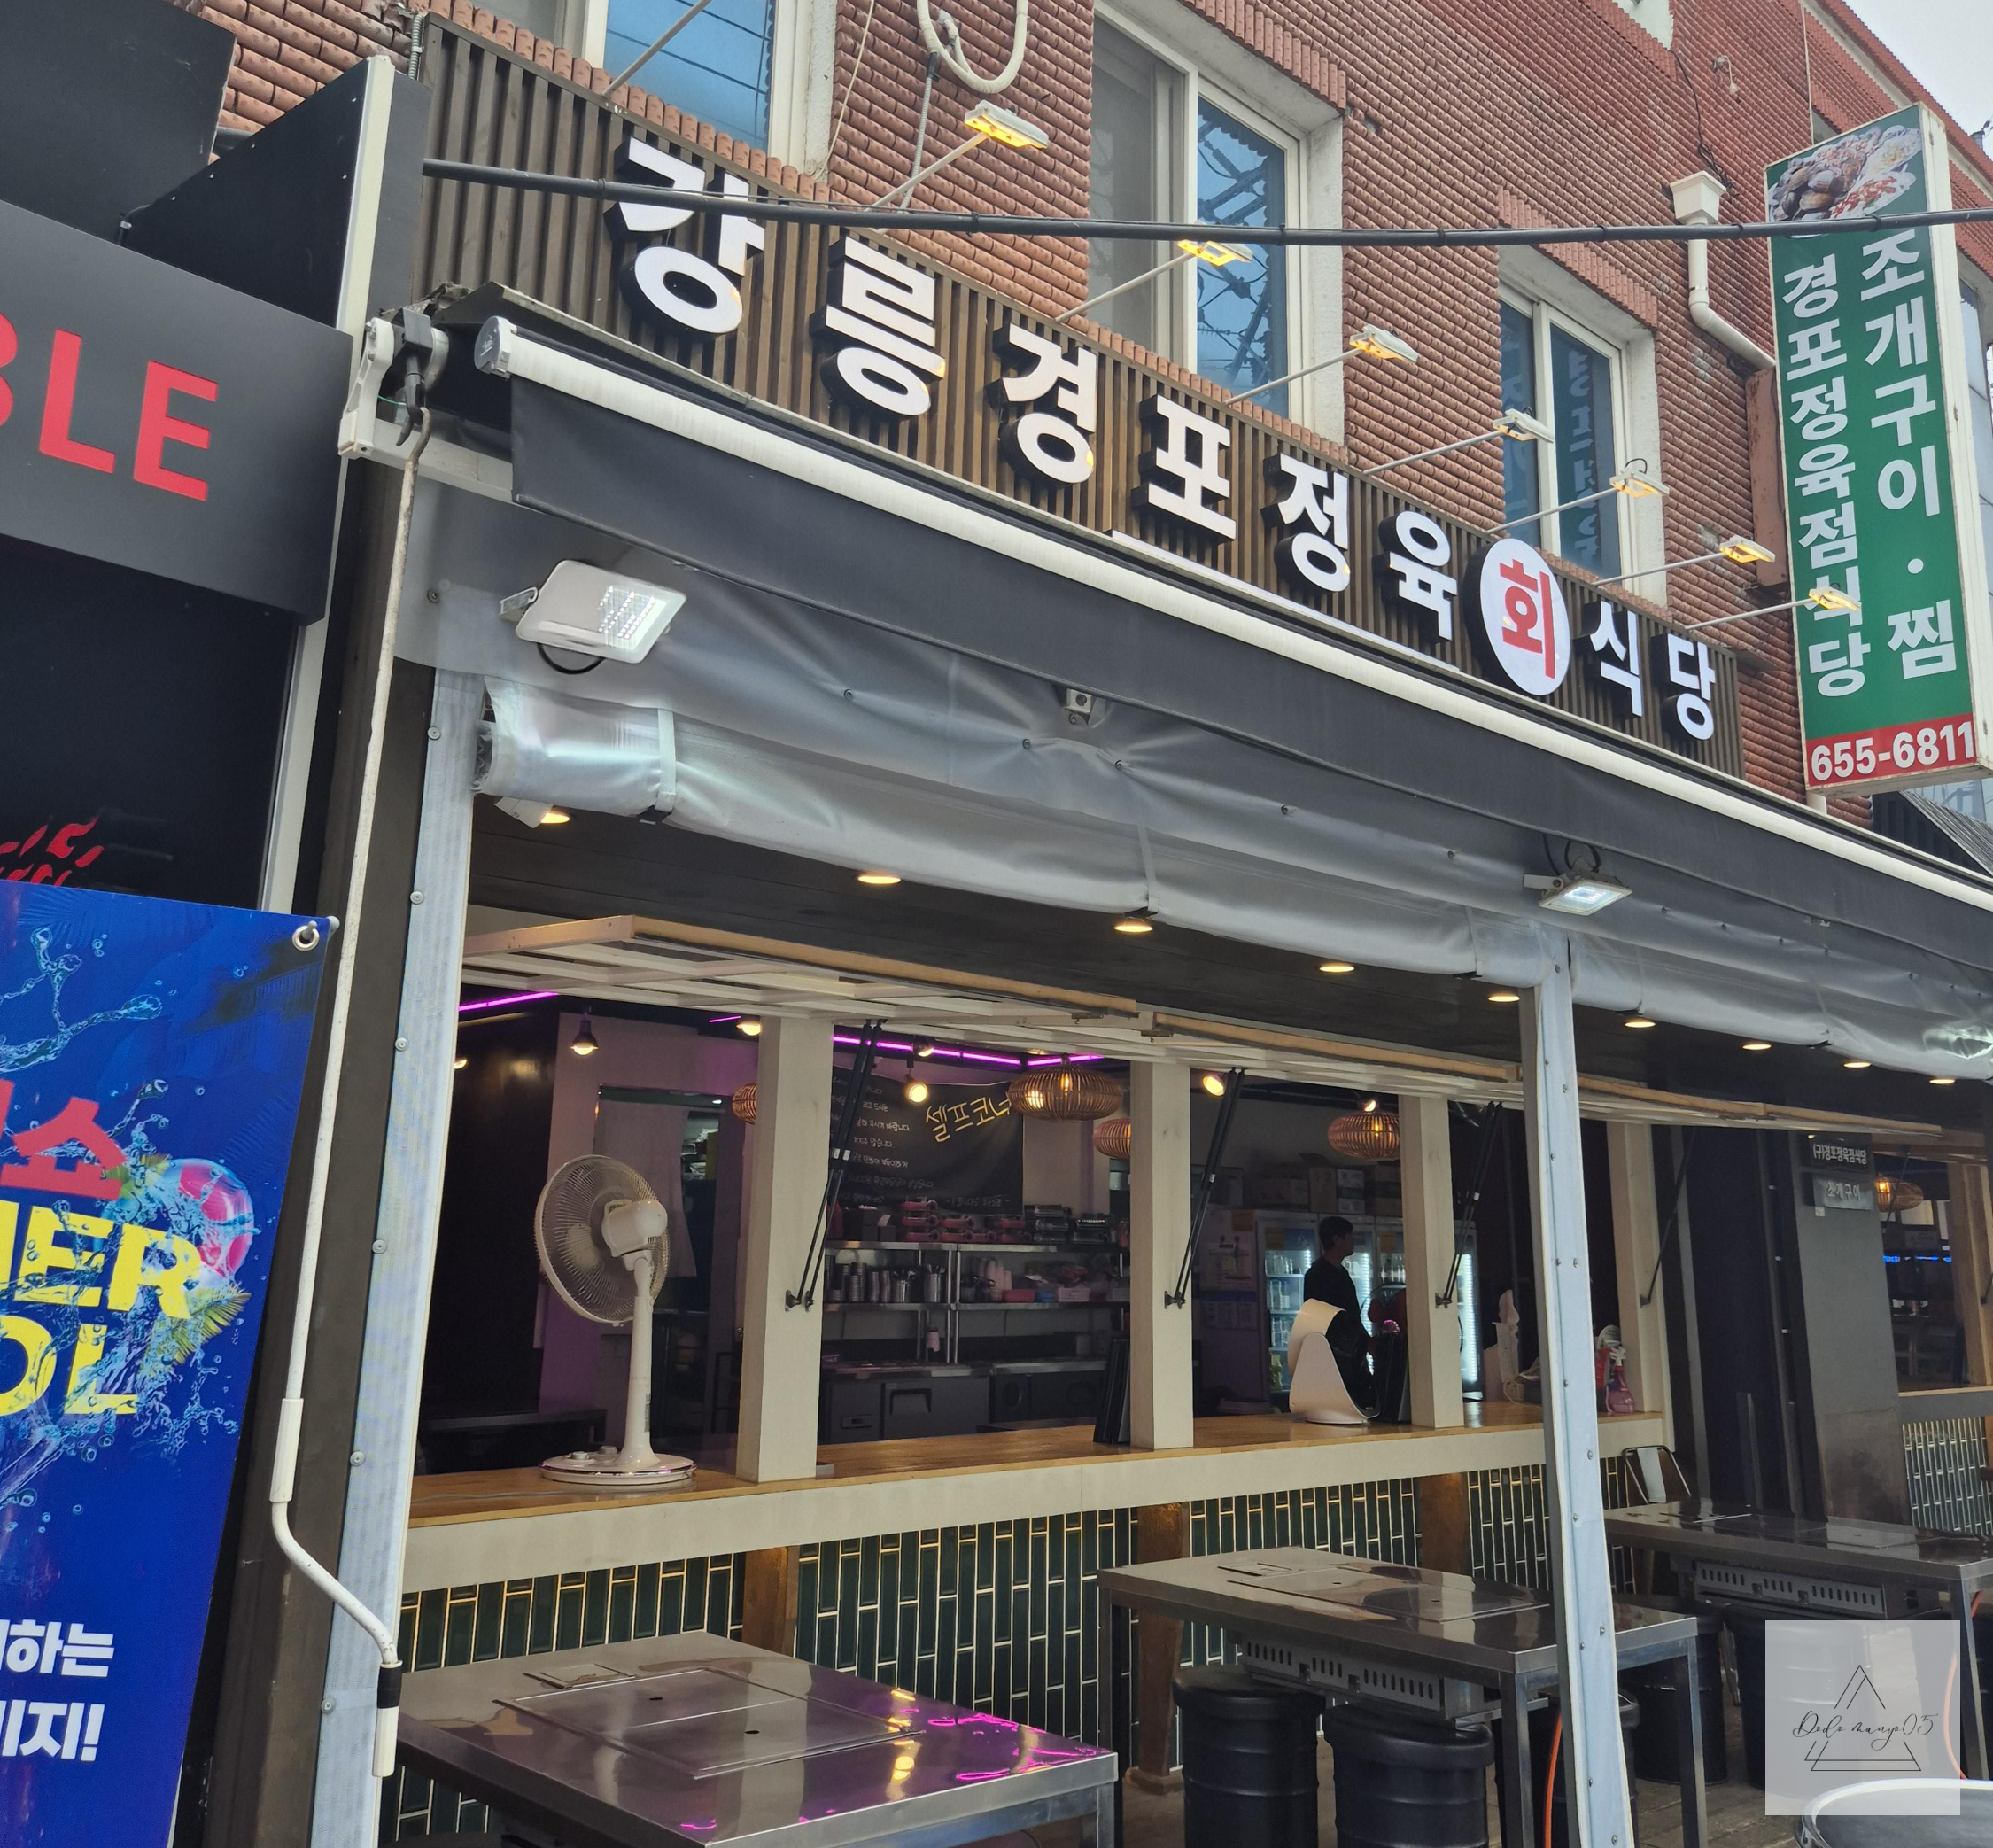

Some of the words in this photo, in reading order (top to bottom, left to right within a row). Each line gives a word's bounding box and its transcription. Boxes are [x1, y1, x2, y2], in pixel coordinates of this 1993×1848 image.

[0, 312, 219, 502] LE
[1811, 721, 1974, 781] 655-6811
[0, 1078, 128, 1201] 쇼
[926, 1091, 1012, 1142] 셀프코너
[0, 1199, 202, 1320] ER
[0, 1619, 114, 1678] 하는
